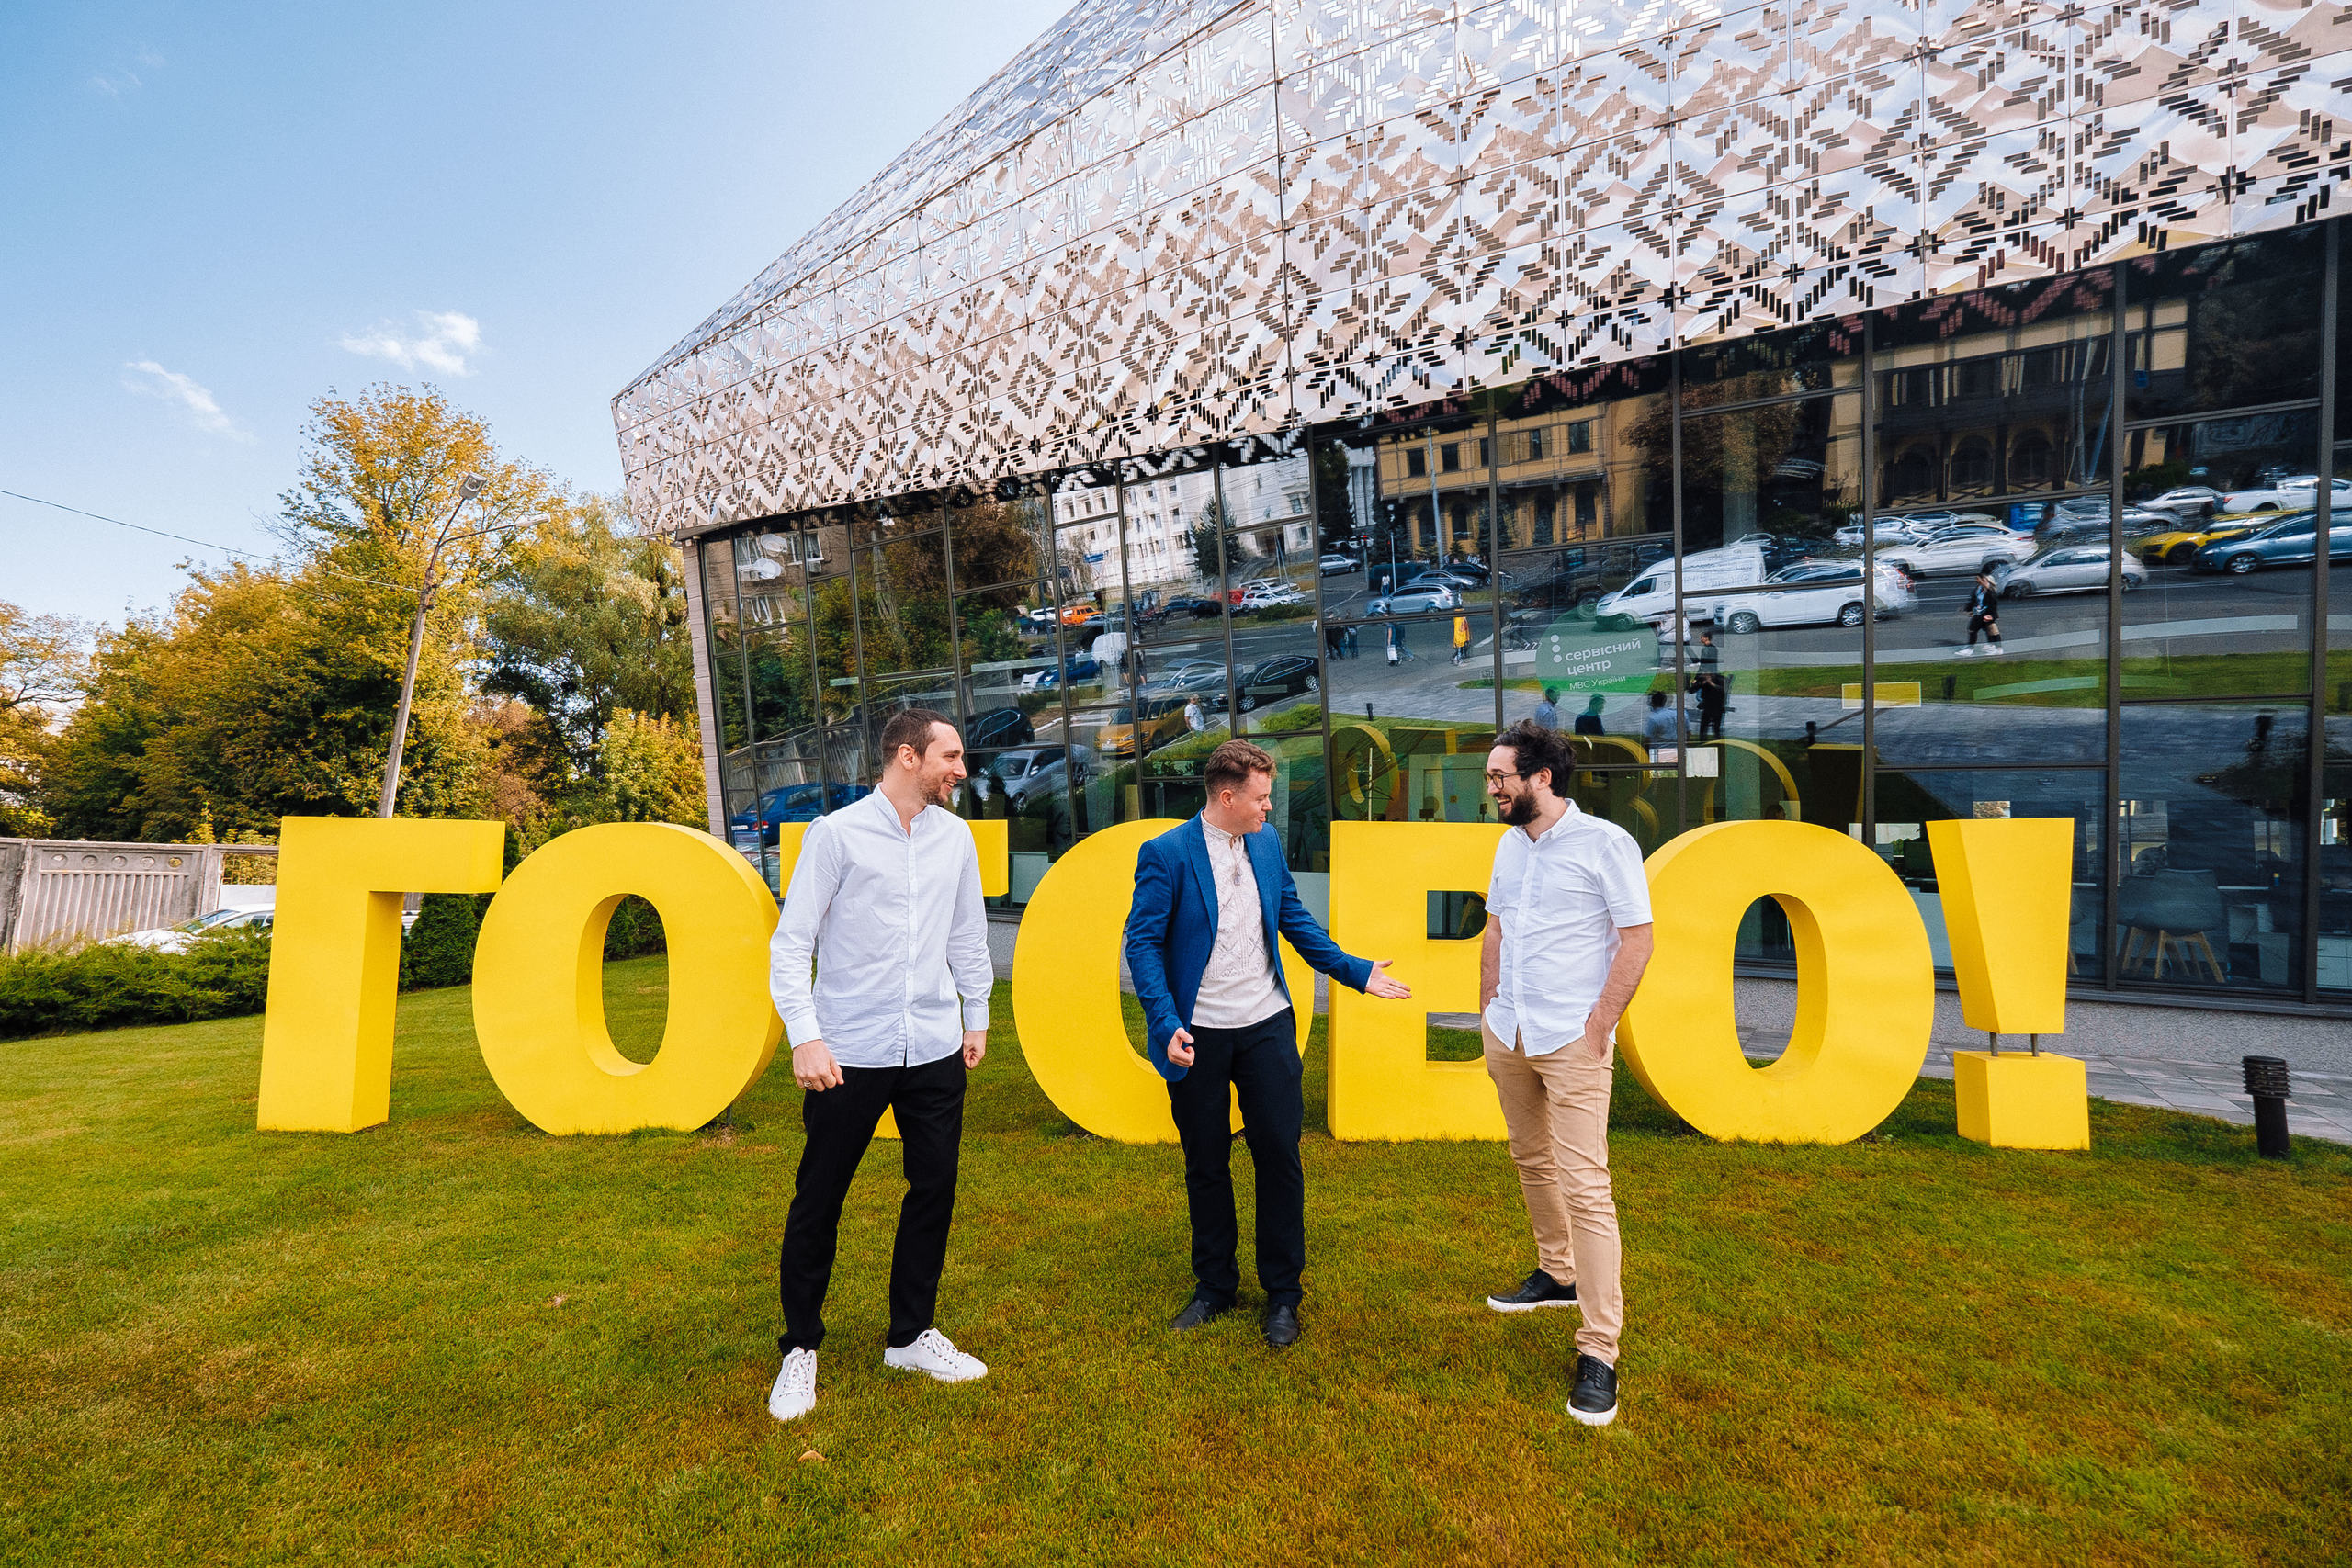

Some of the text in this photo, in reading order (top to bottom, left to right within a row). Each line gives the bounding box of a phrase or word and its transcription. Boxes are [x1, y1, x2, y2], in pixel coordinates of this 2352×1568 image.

[1566, 638, 1641, 661] сервісний
[1567, 660, 1611, 676] центр
[1569, 675, 1626, 691] МВС України
